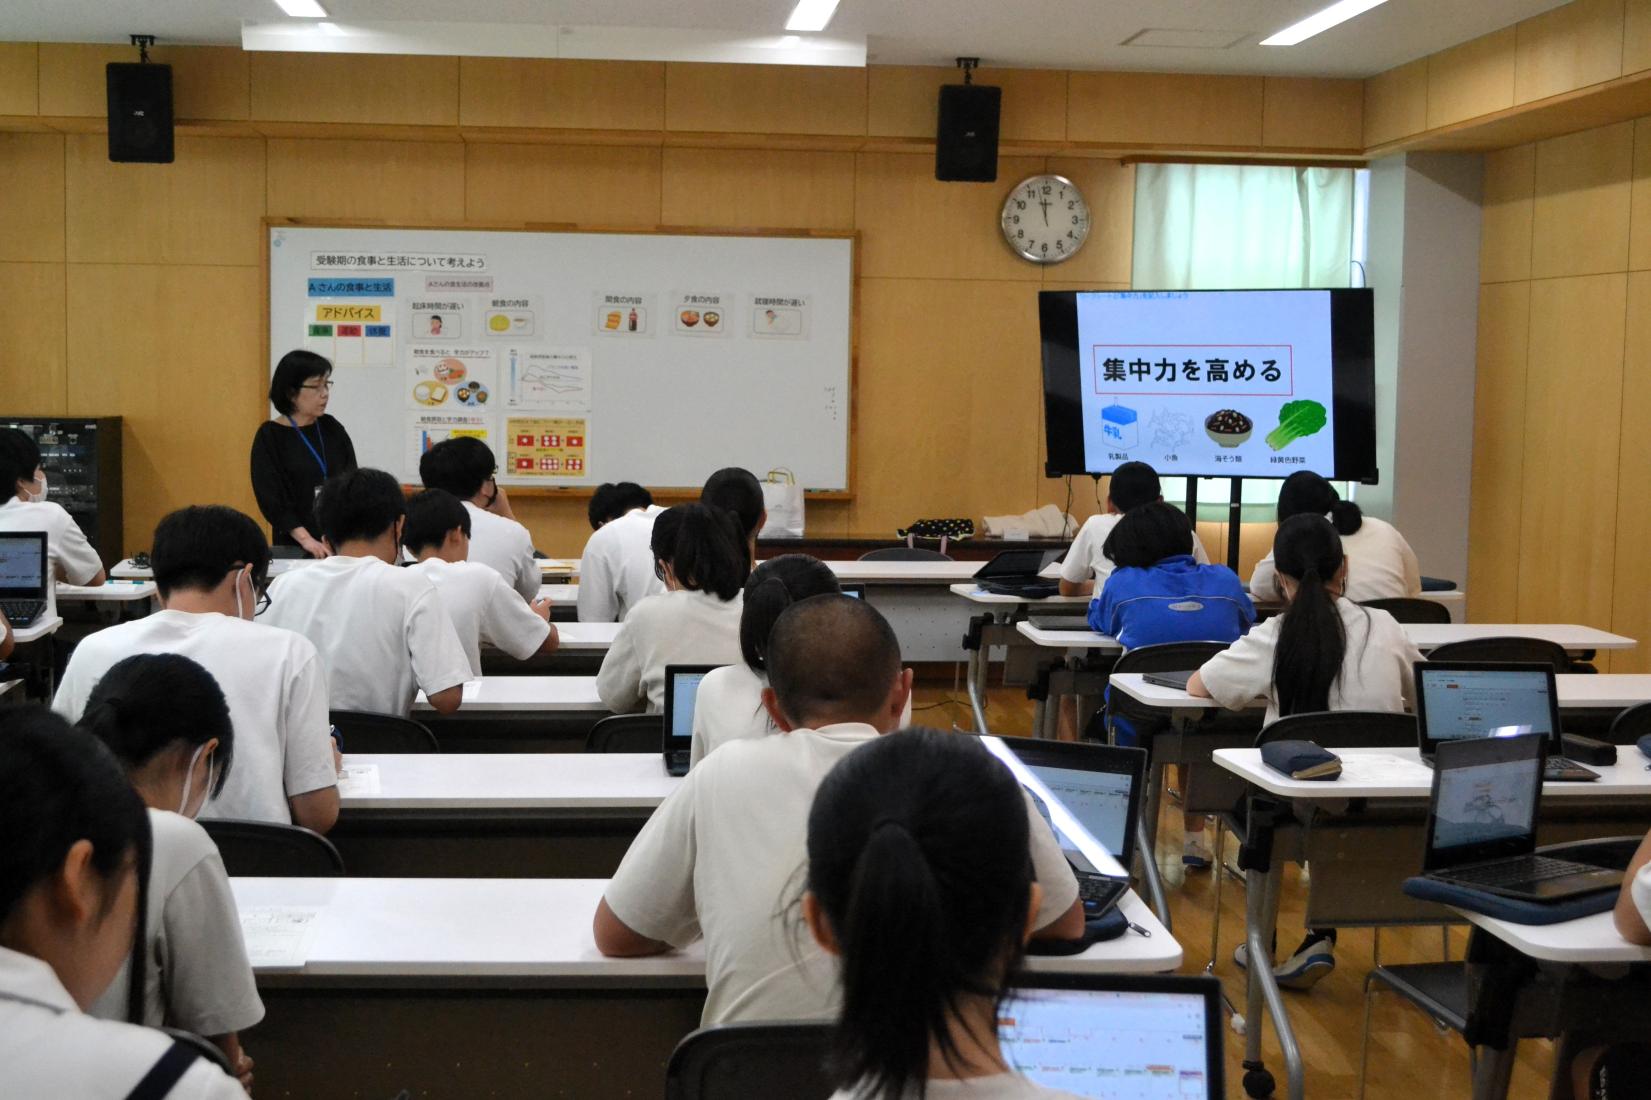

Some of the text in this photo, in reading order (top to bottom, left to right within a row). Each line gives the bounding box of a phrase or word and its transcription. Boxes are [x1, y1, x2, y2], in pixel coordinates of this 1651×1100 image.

[1027, 190, 1035, 199] 11
[1041, 185, 1052, 195] 12
[1059, 190, 1064, 200] 1
[1016, 200, 1026, 210] 10
[1067, 200, 1074, 210] 2
[1013, 215, 1020, 224] 9
[1072, 215, 1078, 225] 3
[1017, 229, 1024, 239] 8
[1066, 230, 1073, 239] 4
[1028, 240, 1035, 249] 7
[1041, 243, 1048, 252] 6
[1056, 240, 1063, 249] 5
[316, 255, 485, 269] 受験期の食事と生活について考えよう
[604, 295, 643, 305] 間食の内容
[683, 294, 720, 305] 夕食の内容
[322, 306, 375, 319] アドバイス
[1102, 357, 1282, 383] 集中力を高める
[1108, 452, 1129, 461] 乳製品
[1164, 454, 1179, 462] 小魚
[1214, 455, 1243, 464] 海そう類
[1269, 456, 1306, 465] 緑黄色野菜
